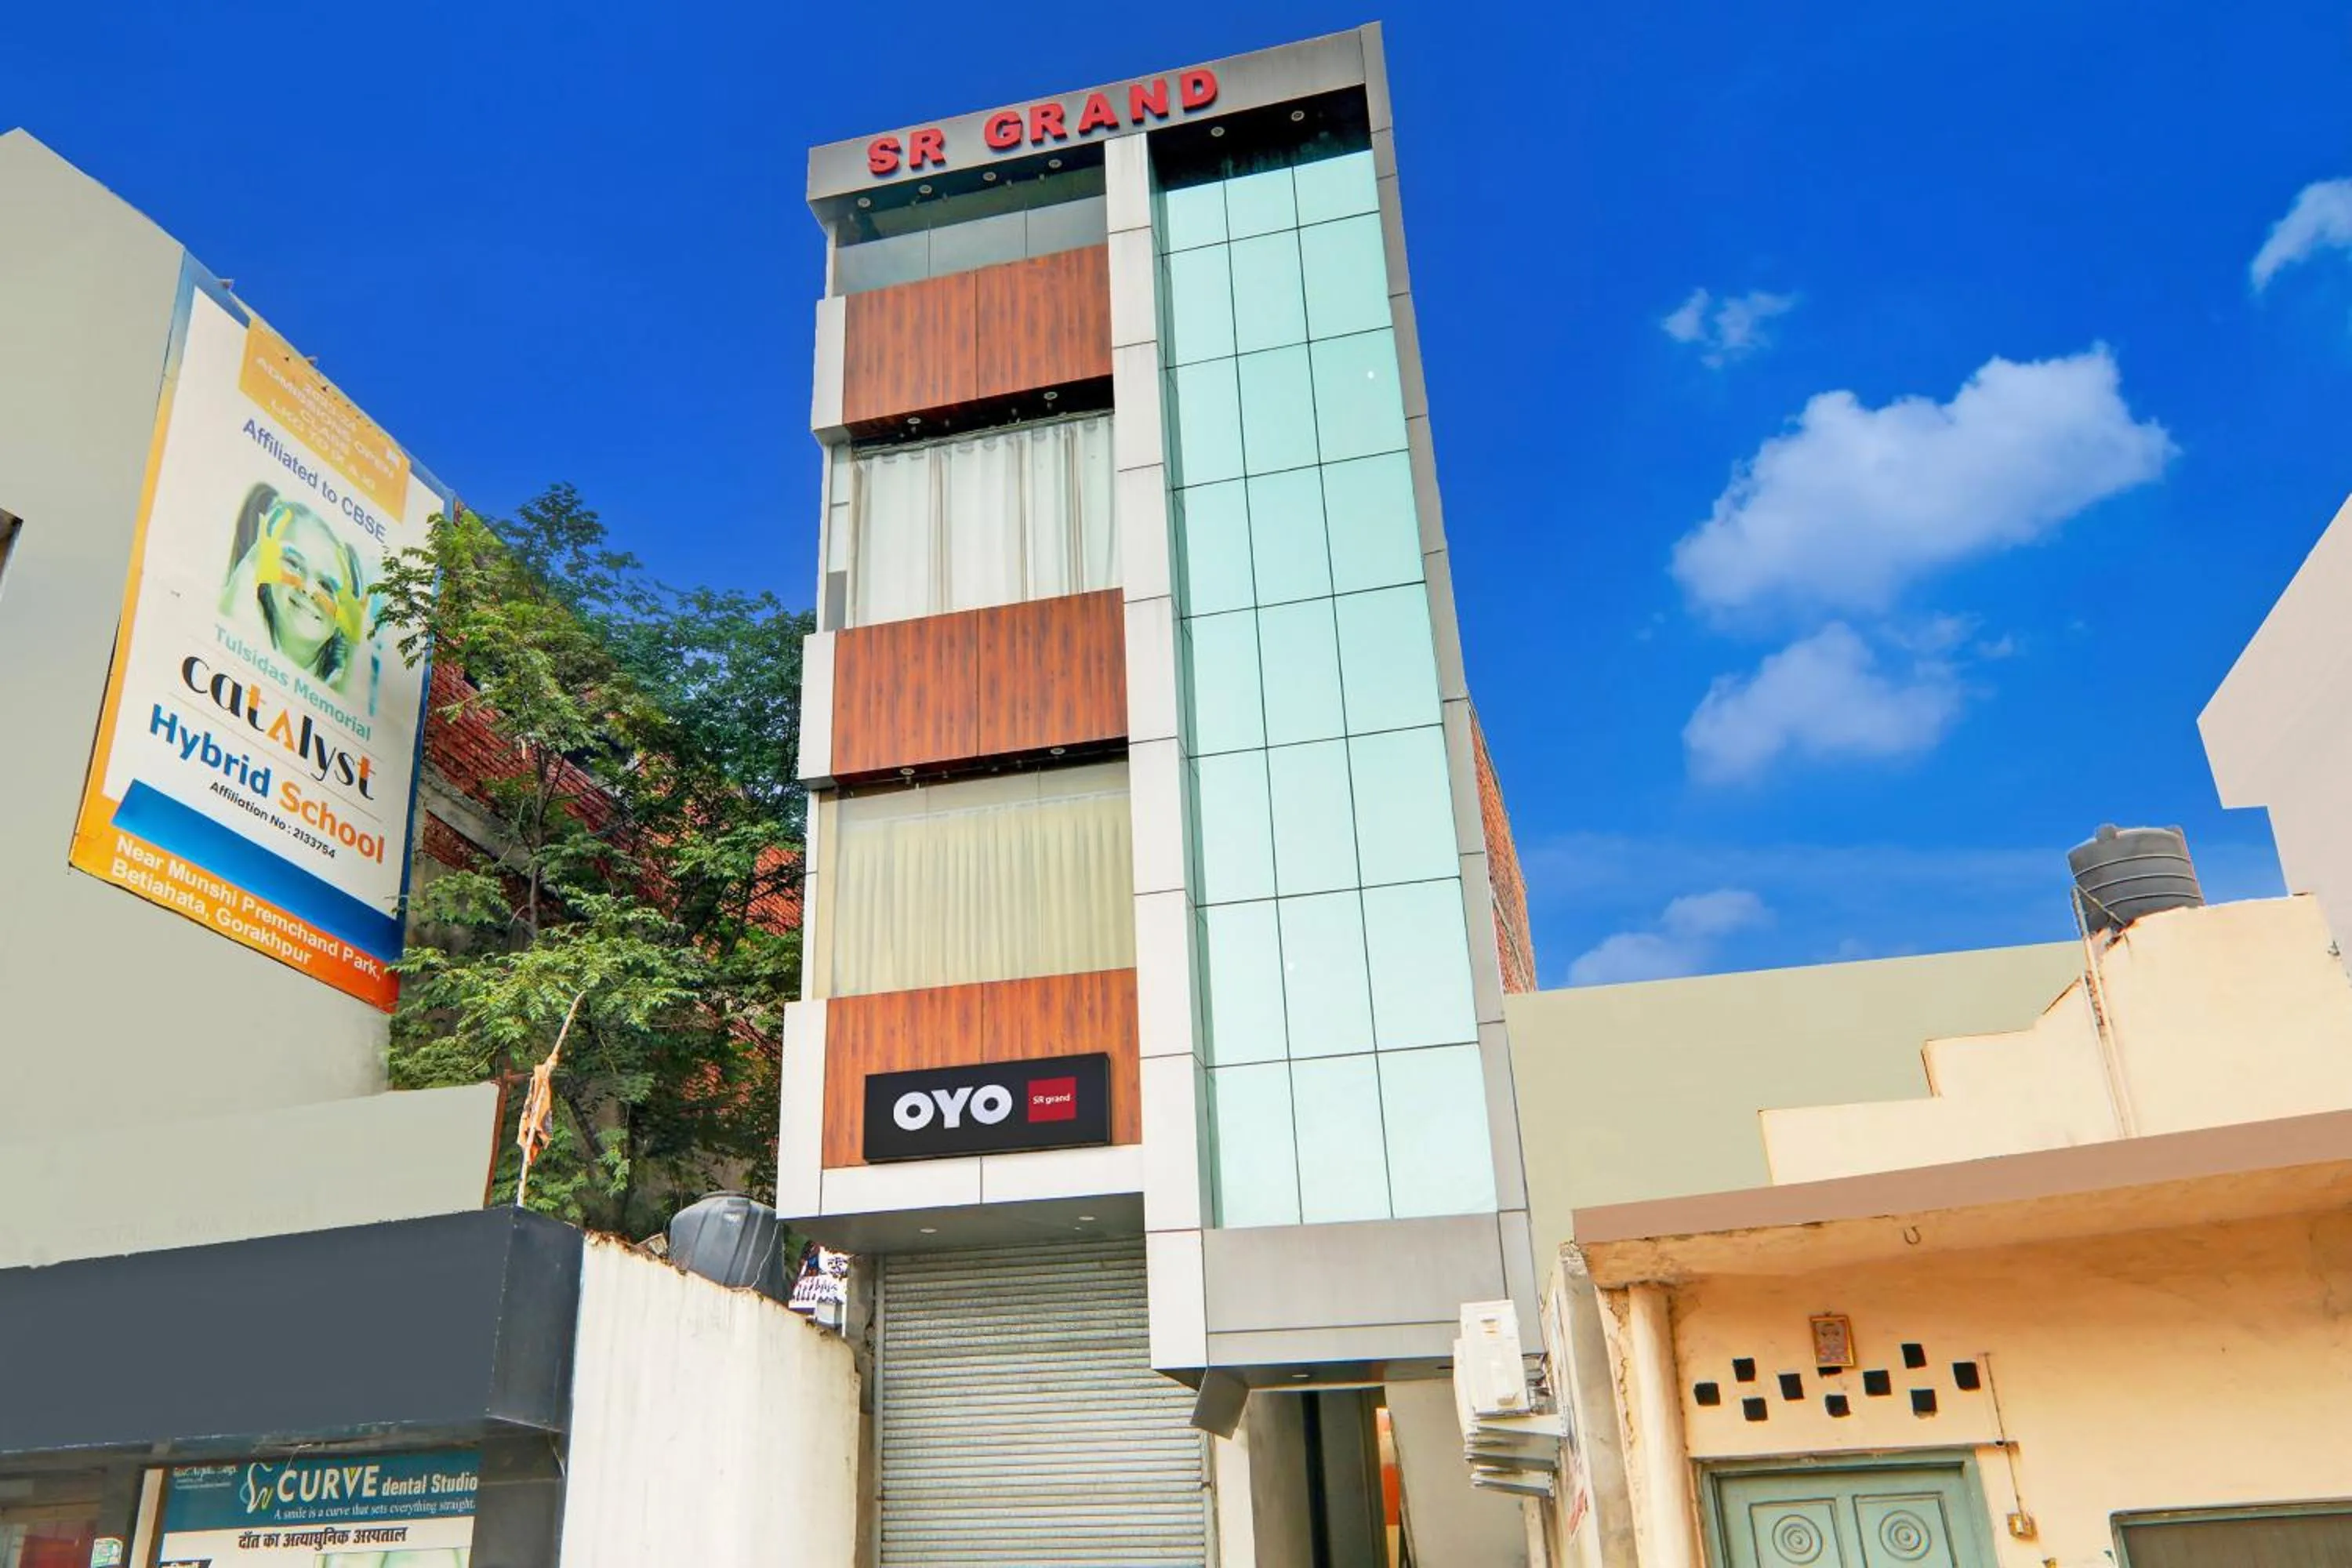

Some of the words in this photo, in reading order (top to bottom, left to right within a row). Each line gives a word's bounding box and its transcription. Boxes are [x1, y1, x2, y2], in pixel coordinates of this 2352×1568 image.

[867, 128, 946, 174] SR
[984, 68, 1218, 151] GRAND
[243, 419, 318, 489] Affiliated
[322, 481, 338, 503] to
[341, 496, 386, 543] CBSE
[215, 624, 289, 687] Tulsidas
[294, 677, 372, 741] Memorial
[149, 703, 272, 798] Hybrid
[279, 780, 385, 864] School
[209, 782, 268, 821] Affiliation
[293, 828, 336, 858] 2133754
[111, 857, 210, 920] Betiahata,
[216, 907, 312, 964] Gorakhpur
[117, 834, 164, 870] Near
[169, 859, 238, 906] Munshi
[241, 896, 338, 957] Premchand
[342, 946, 380, 982] Park,
[893, 1084, 1012, 1131] OYO
[1033, 1095, 1044, 1105] SR
[1045, 1093, 1070, 1105] grand
[274, 1509, 281, 1520] A
[283, 1506, 307, 1519] smile
[308, 1508, 316, 1519] is
[325, 1508, 352, 1518] curve
[353, 1504, 368, 1515] that
[370, 1504, 389, 1515] sets
[390, 1501, 437, 1515] everything
[278, 1465, 380, 1503] CURVE
[382, 1475, 426, 1497] dental
[431, 1472, 477, 1494] Studio
[263, 1532, 281, 1548] का
[353, 1527, 408, 1544] अस्पताल
